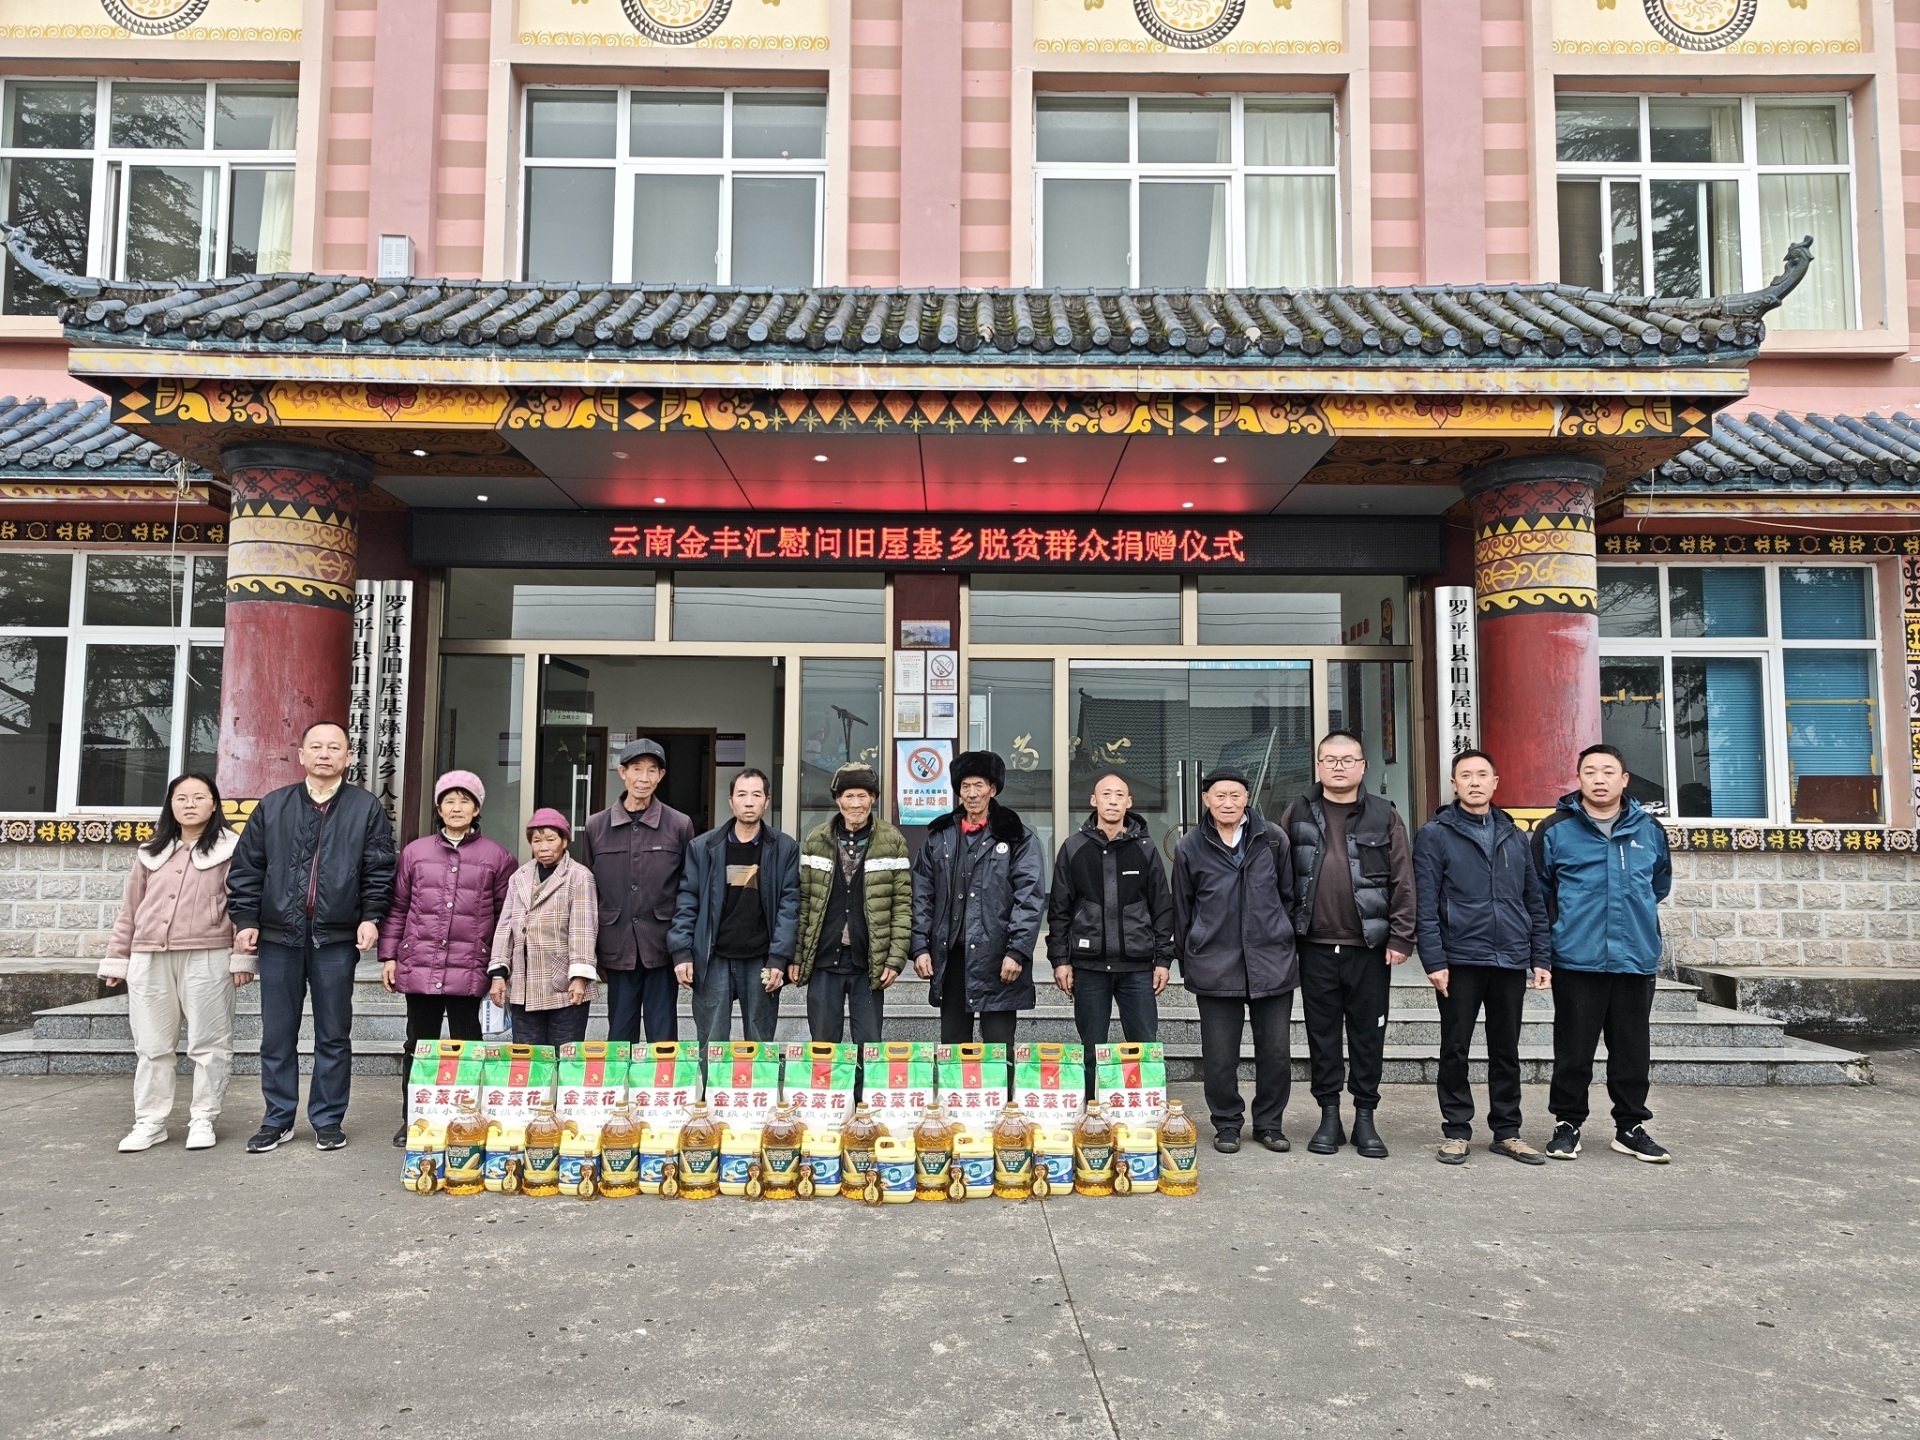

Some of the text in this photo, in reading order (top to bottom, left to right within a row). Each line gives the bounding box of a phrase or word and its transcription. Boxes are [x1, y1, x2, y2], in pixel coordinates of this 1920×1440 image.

[609, 525, 1245, 563] 云南金丰汇慰问旧屋基乡脱贫群众捐赠仪式
[377, 594, 407, 837] 罗平县旧屋基彝族乡人民
[903, 796, 947, 806] 禁止吸烟
[415, 1088, 470, 1105] 金菜花
[488, 1090, 541, 1106] 金菜花
[564, 1090, 616, 1106] 金菜花
[636, 1090, 687, 1106] 金菜花
[714, 1091, 768, 1107] 金菜花
[792, 1092, 845, 1109] 金菜花
[871, 1092, 925, 1107] 金菜花
[948, 1091, 1000, 1107] 金菜花
[1024, 1092, 1077, 1109] 金菜花
[1109, 1091, 1161, 1107] 金菜花
